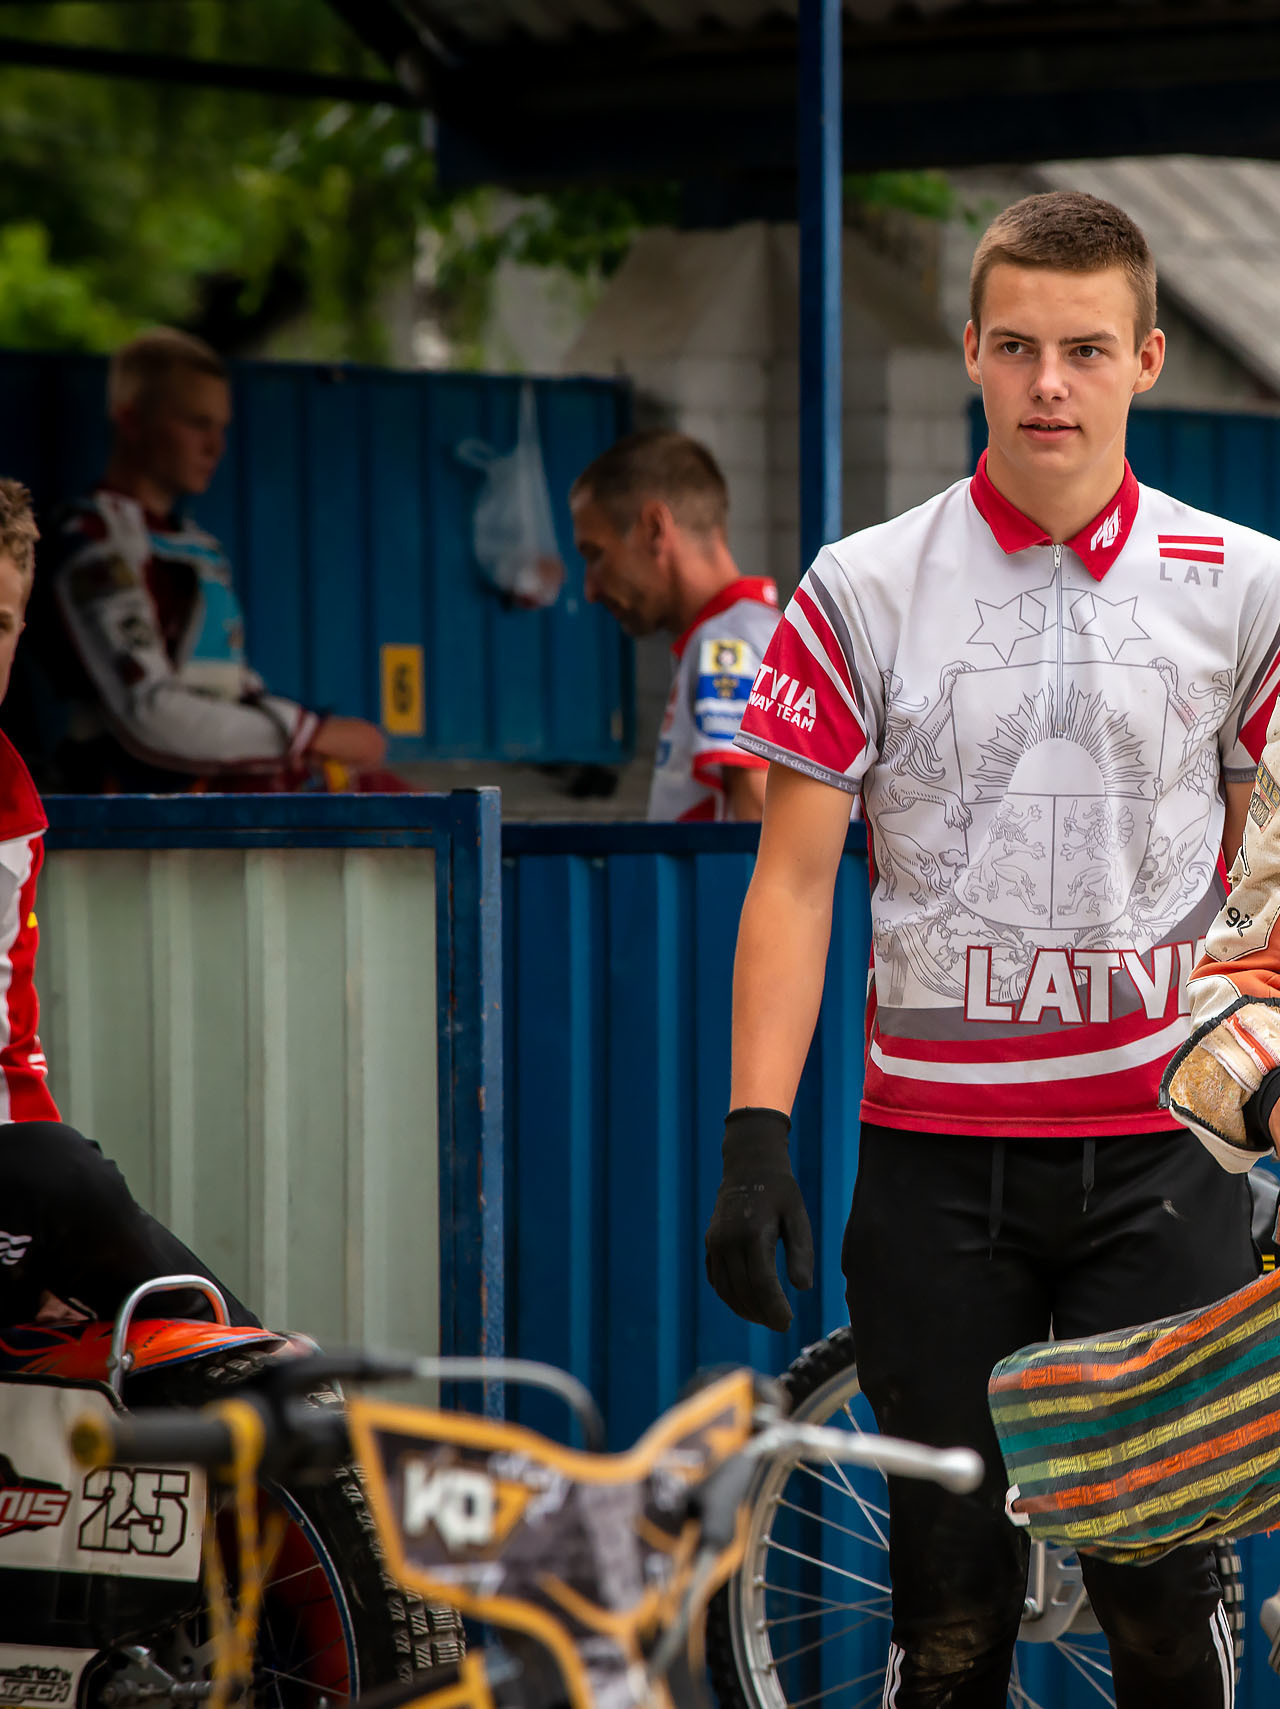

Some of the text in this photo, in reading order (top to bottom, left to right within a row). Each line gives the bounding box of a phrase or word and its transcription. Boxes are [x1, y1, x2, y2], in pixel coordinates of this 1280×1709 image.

[1159, 562, 1224, 588] LAT
[777, 703, 816, 733] TEAM
[963, 936, 1206, 1025] LATVI
[78, 1465, 190, 1557] 25
